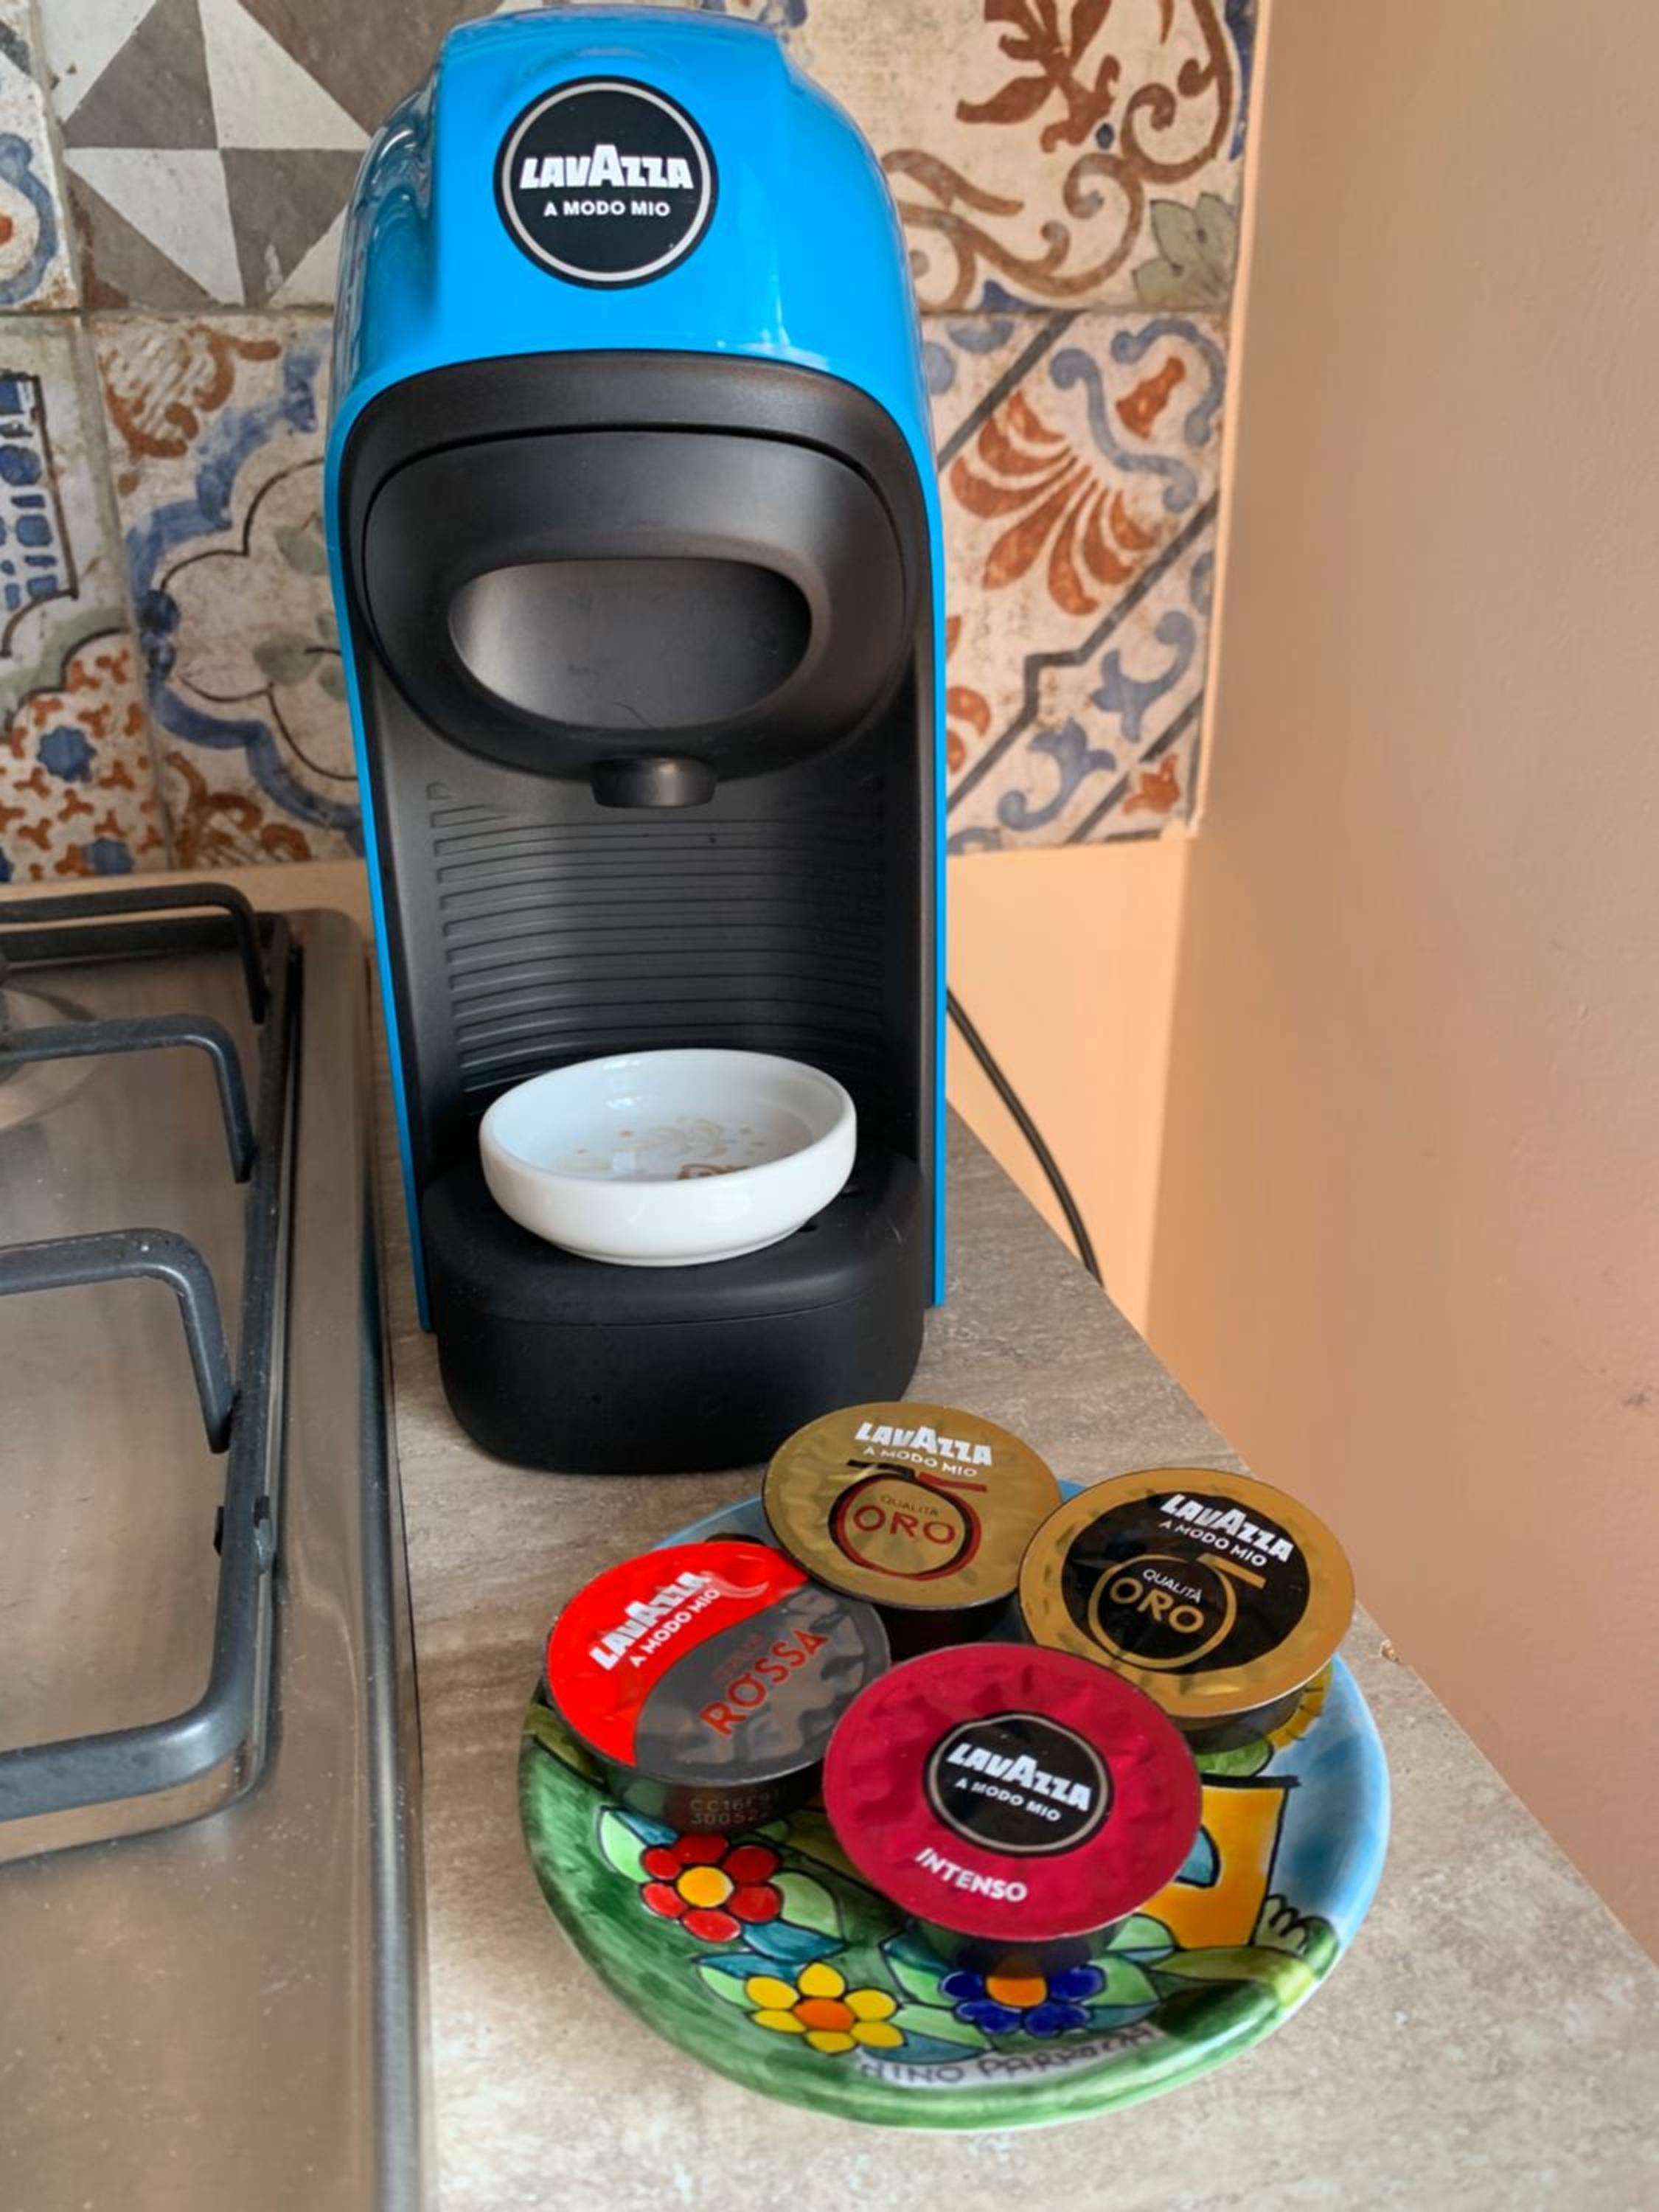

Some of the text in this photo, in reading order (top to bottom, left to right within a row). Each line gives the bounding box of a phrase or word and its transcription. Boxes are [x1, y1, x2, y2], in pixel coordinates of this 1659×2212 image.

[520, 144, 694, 189] LAVAZZA
[543, 201, 670, 217] A MODO MIO
[855, 1422, 992, 1467] LAVAZZA
[863, 1446, 978, 1478] A MODO MIO
[853, 1505, 956, 1545] ORO
[1158, 1520, 1267, 1567] A MODO MIO
[1160, 1494, 1294, 1562] LAVAZZA
[590, 1571, 712, 1672] LAVAZZA
[629, 1588, 720, 1669] A MODO MIO
[1110, 1576, 1204, 1634] ORO
[700, 1628, 830, 1736] ROSSA
[947, 1743, 1092, 1812] LAVAZZA
[955, 1777, 1062, 1822] A MODO MIO
[914, 1848, 1028, 1902] INTENSO
[860, 2062, 965, 2084] NINO
